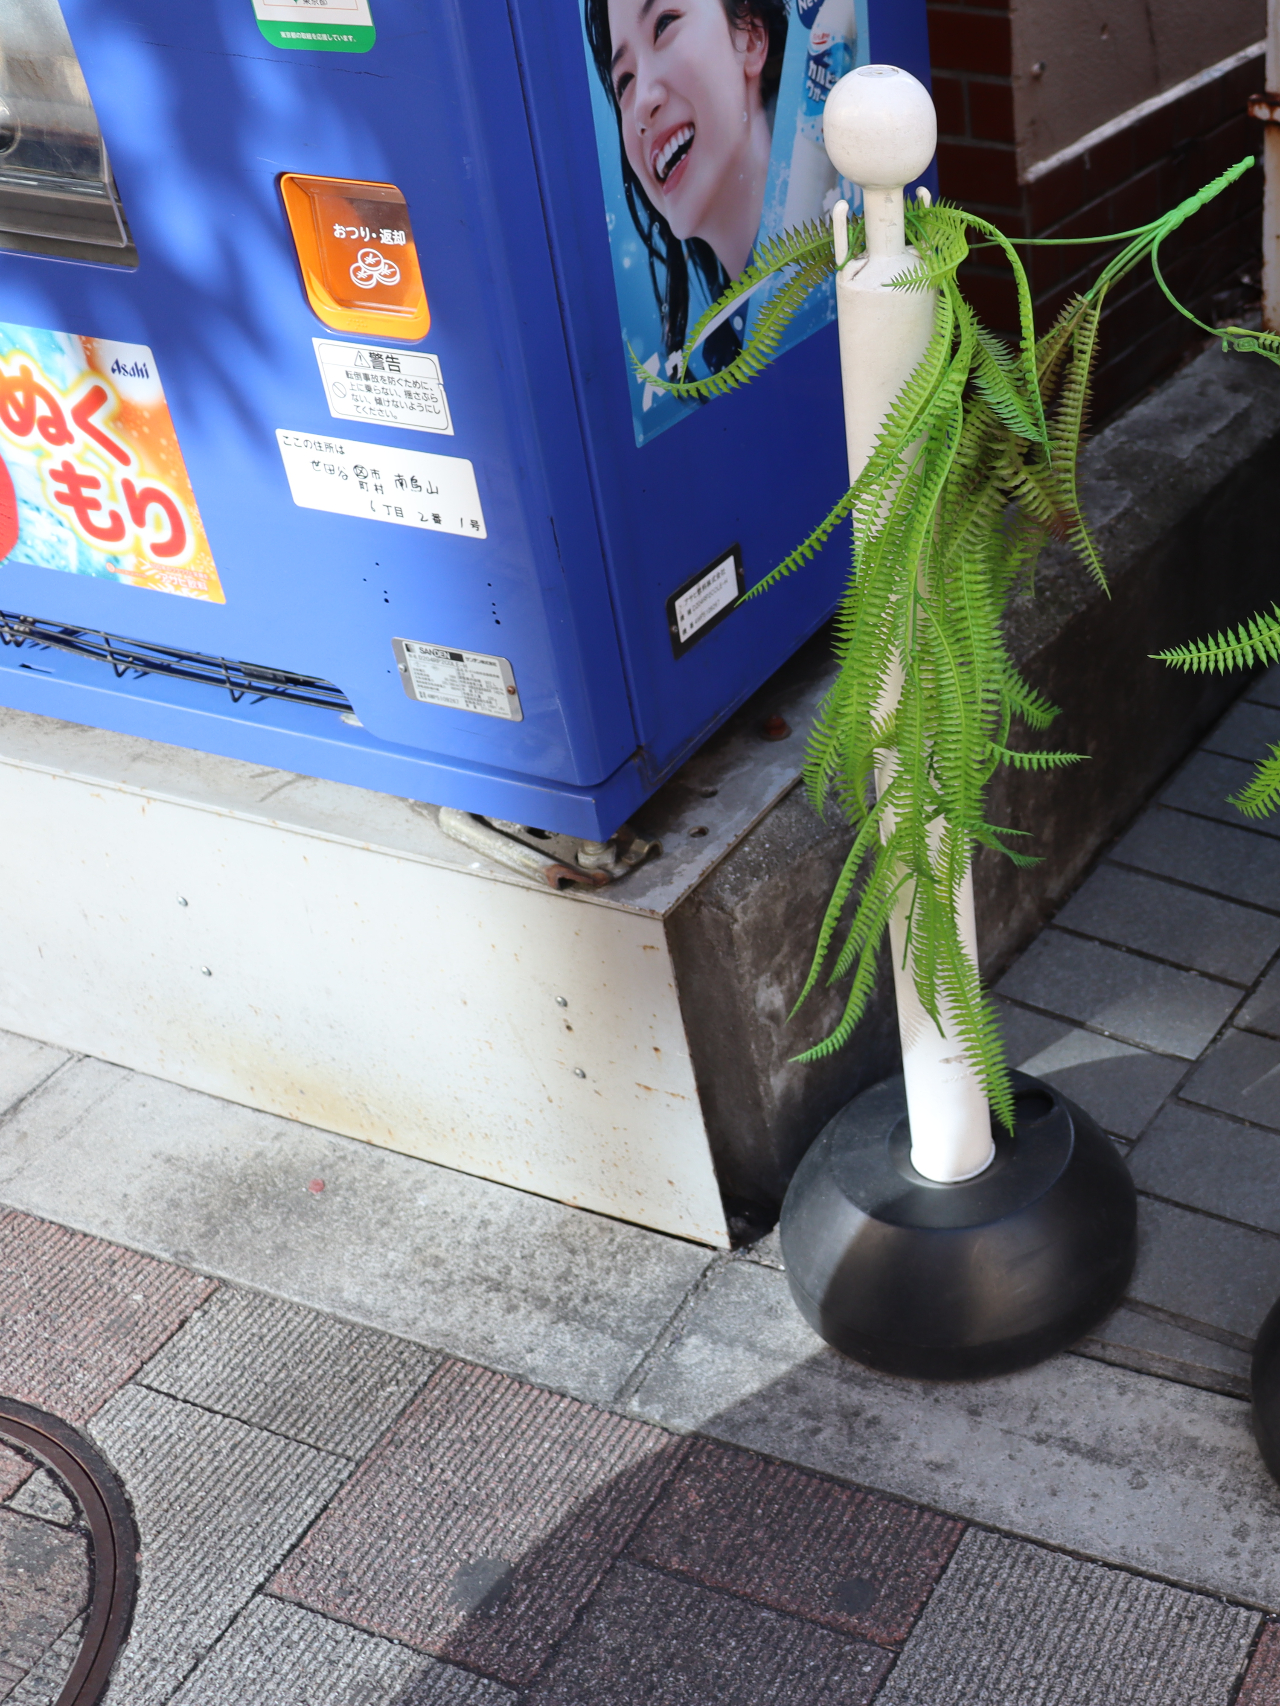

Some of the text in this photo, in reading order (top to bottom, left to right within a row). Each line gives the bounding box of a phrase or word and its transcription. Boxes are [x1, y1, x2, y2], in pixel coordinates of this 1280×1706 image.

[332, 222, 407, 246] おつり・返却
[110, 358, 150, 380] Asahi
[368, 351, 401, 373] 警告
[344, 370, 433, 391] 転倒事故を防ぐために、
[353, 404, 398, 420] てください。
[283, 435, 345, 455] ここの住所は
[48, 460, 187, 559] もり
[418, 646, 450, 660] SANDEN
